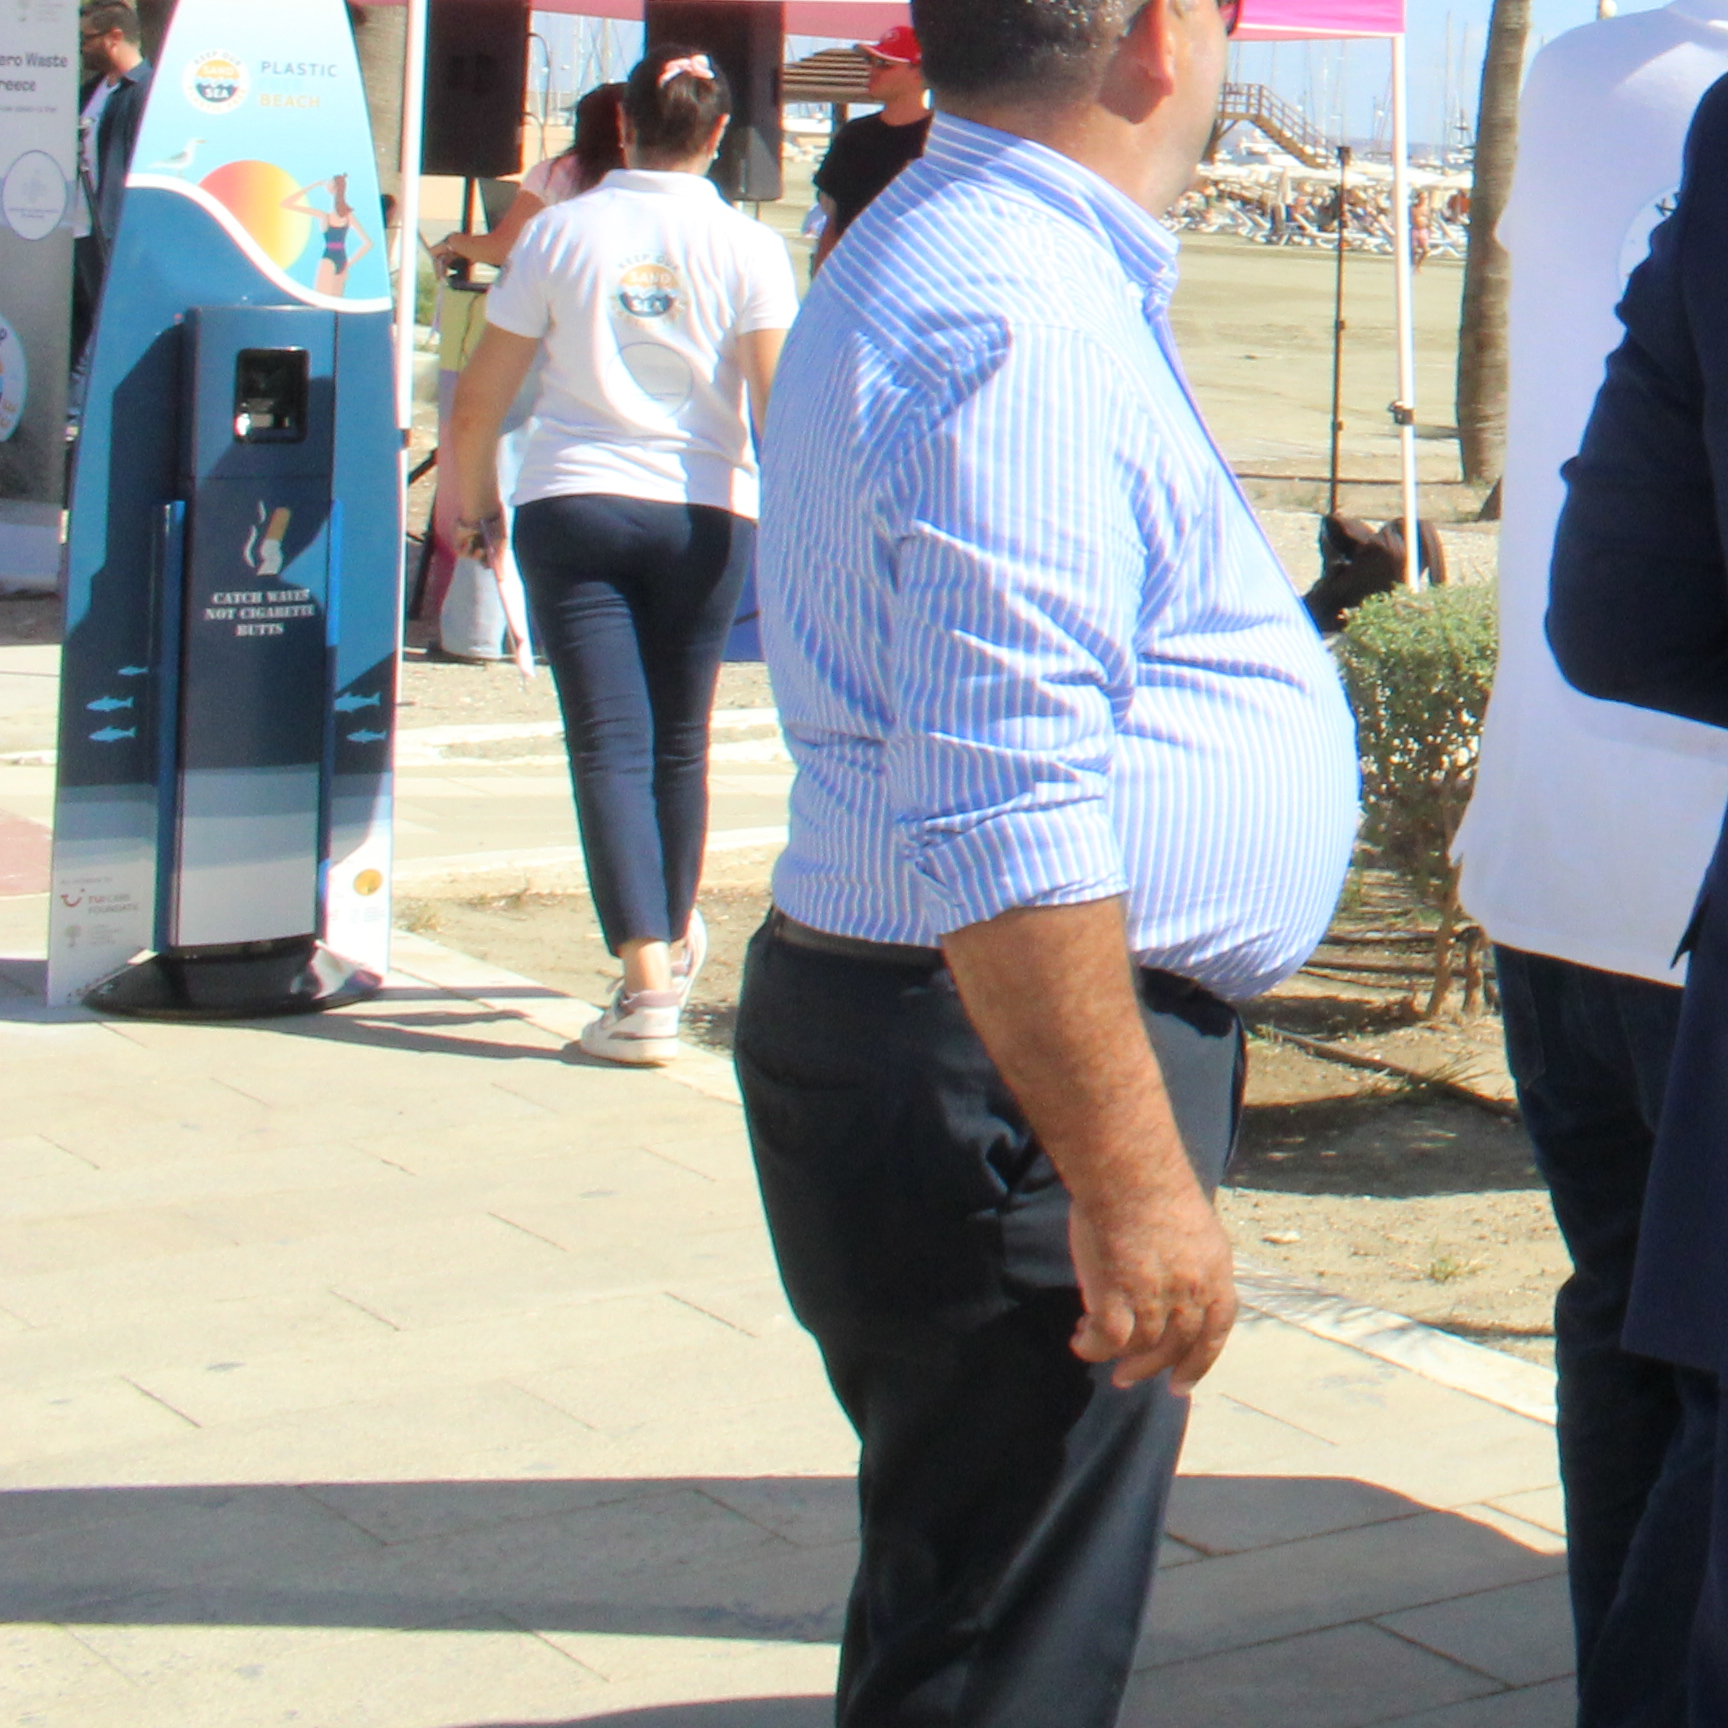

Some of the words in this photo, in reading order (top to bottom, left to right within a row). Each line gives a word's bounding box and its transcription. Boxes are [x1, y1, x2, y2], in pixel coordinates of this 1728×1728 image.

[0, 55, 23, 68] ero
[260, 60, 338, 78] PLASTIC
[0, 79, 37, 92] reece
[259, 93, 320, 109] BEACH
[211, 592, 263, 605] CATCH
[204, 607, 238, 621] NOT
[234, 622, 285, 636] BUTTS
